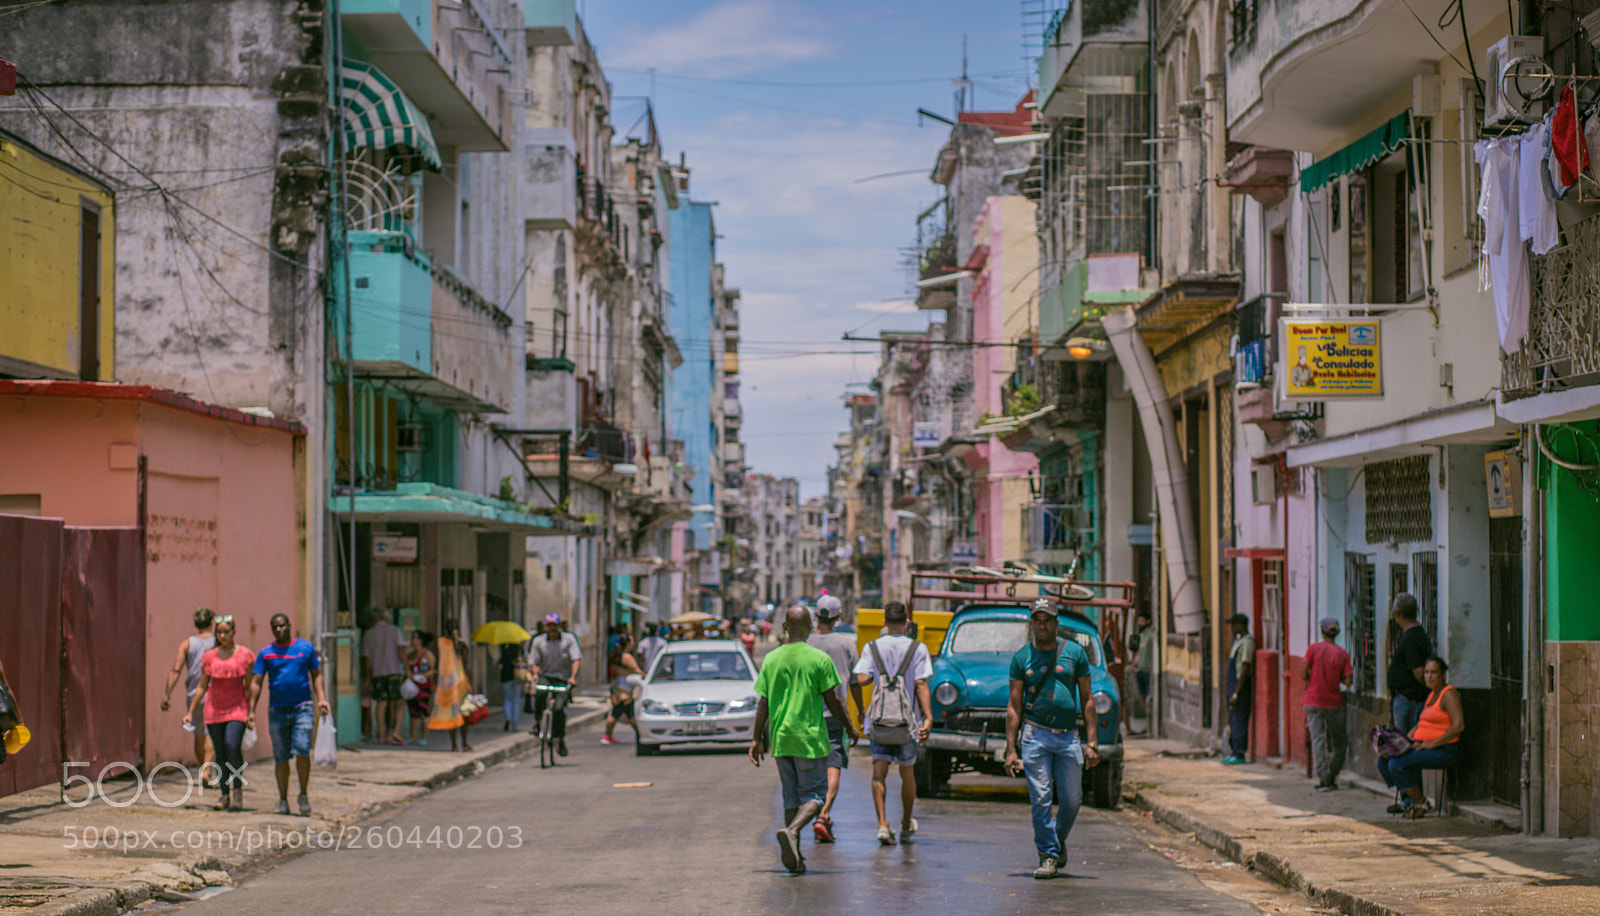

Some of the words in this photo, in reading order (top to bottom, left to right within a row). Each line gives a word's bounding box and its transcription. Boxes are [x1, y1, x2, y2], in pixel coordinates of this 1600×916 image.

[1317, 342, 1337, 351] Las
[1327, 345, 1373, 356] Delicias
[1316, 358, 1375, 369] Consulado
